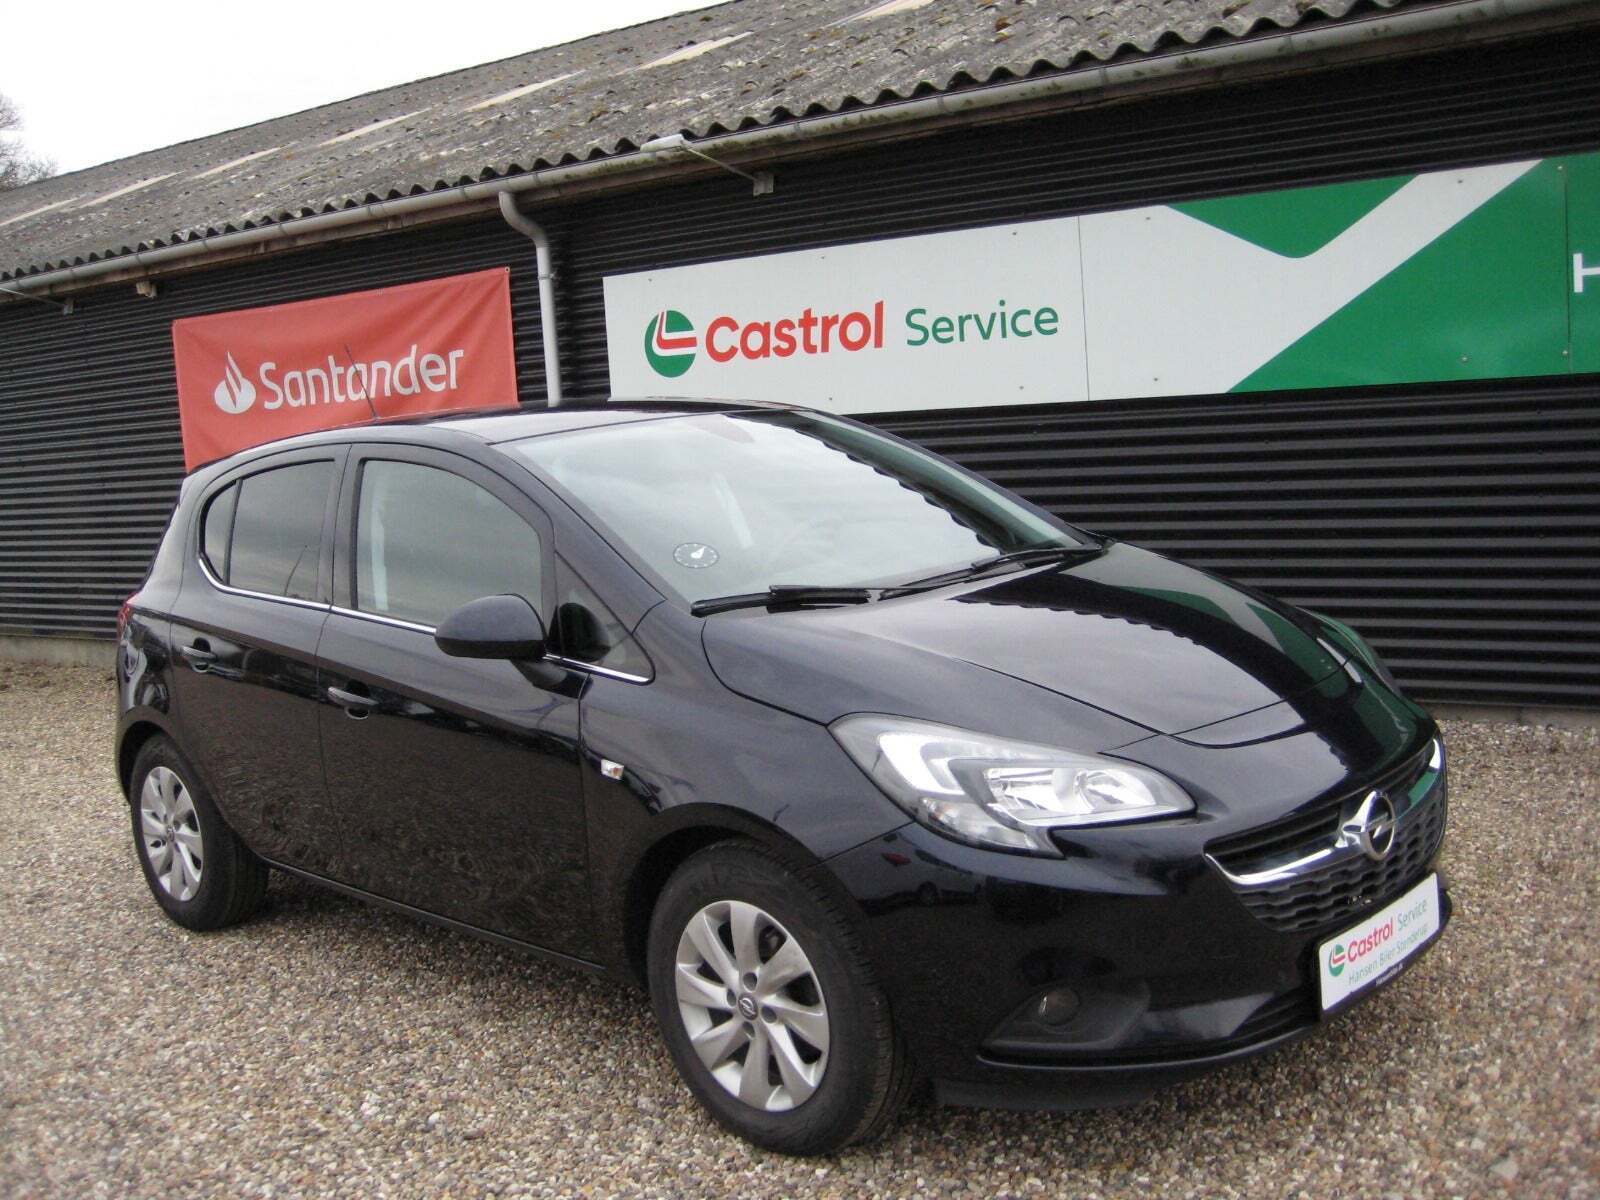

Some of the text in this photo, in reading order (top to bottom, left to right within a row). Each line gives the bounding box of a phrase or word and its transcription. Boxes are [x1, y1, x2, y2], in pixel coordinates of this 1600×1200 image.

[705, 299, 1059, 363] Castrol Service
[259, 344, 464, 410] Santander
[1347, 899, 1428, 963] Castrol Service
[1348, 959, 1378, 986] Hansen
